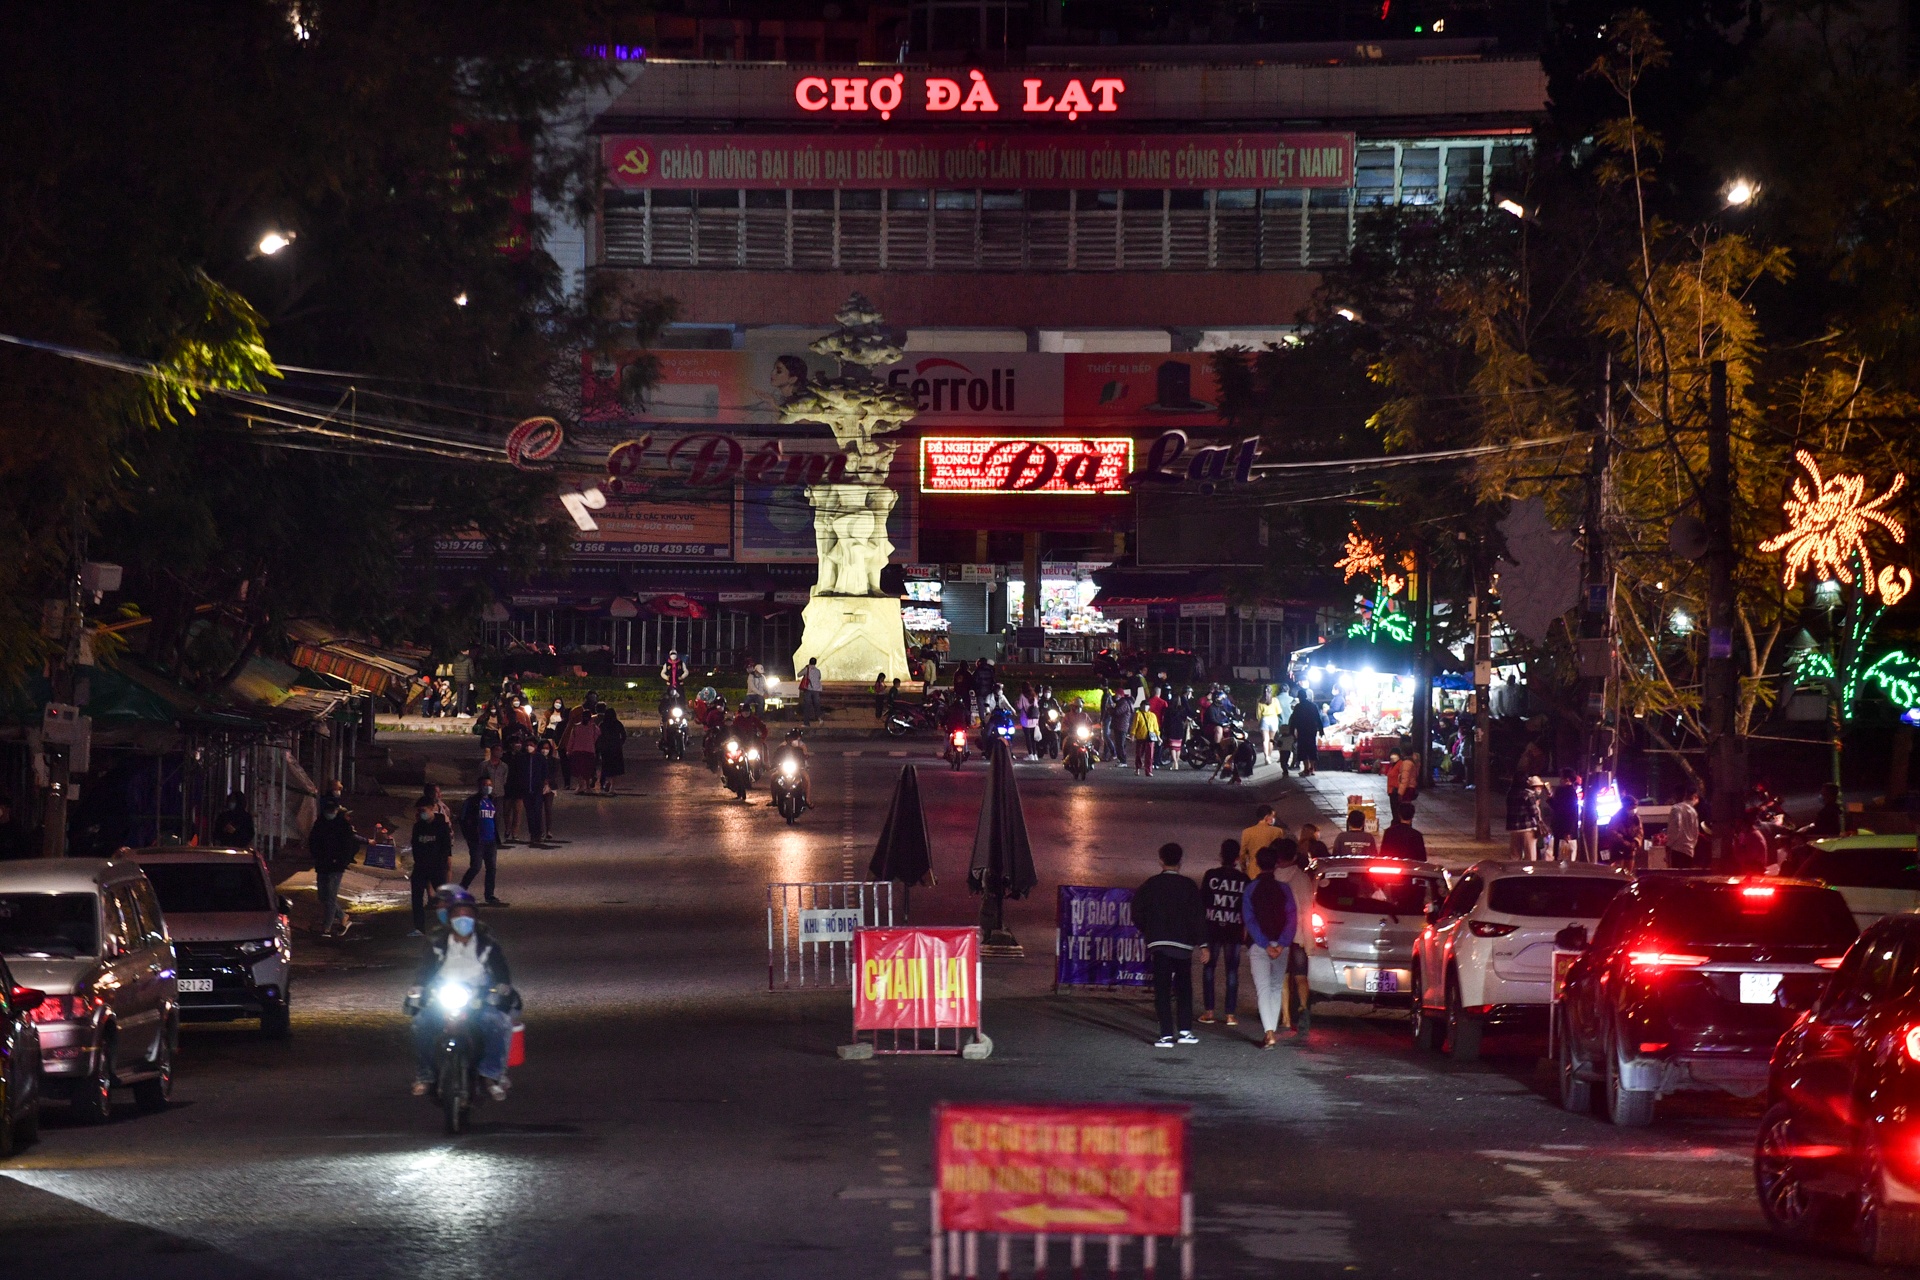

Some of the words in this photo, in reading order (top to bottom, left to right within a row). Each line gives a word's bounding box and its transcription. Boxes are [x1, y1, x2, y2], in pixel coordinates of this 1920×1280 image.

[795, 72, 905, 121] CHỢ
[925, 69, 999, 112] ĐÀ
[1022, 78, 1126, 121] LẠT
[660, 143, 704, 180] CHÀO
[709, 143, 757, 180] MỪNG
[761, 149, 788, 187] ĐẠI
[793, 143, 820, 187] HỘI
[825, 149, 852, 187] ĐẠI
[857, 137, 893, 180] BIỂU
[898, 143, 940, 180] TOÀN
[944, 139, 987, 182] QUỐC
[990, 138, 1021, 180] LẦN
[1026, 143, 1058, 180] THỨ
[1060, 149, 1086, 180] XIII
[1091, 139, 1123, 180] CỦA
[1127, 139, 1171, 180] ĐẢNG
[1175, 143, 1219, 186] CỘNG
[1223, 138, 1257, 179] SẢN
[1261, 142, 1296, 185] VIỆT
[1299, 147, 1343, 178] NAM!
[1087, 361, 1117, 374] THIẾT
[932, 454, 969, 465] TRONG
[932, 478, 968, 488] TRONG
[462, 541, 483, 551] 746
[584, 543, 605, 552] 566
[633, 544, 660, 553] 0918
[661, 544, 682, 554] 439
[684, 545, 706, 555] 566
[1213, 893, 1239, 909] MY
[1087, 896, 1116, 926] GIÁC
[1205, 908, 1243, 925] MAMA
[837, 917, 846, 933] ĐI
[1077, 929, 1092, 961] TẾ
[1094, 936, 1113, 967] TẠI
[865, 950, 928, 1010] CHẬM
[934, 957, 967, 1009] LẠI
[1116, 970, 1134, 980] Xin
